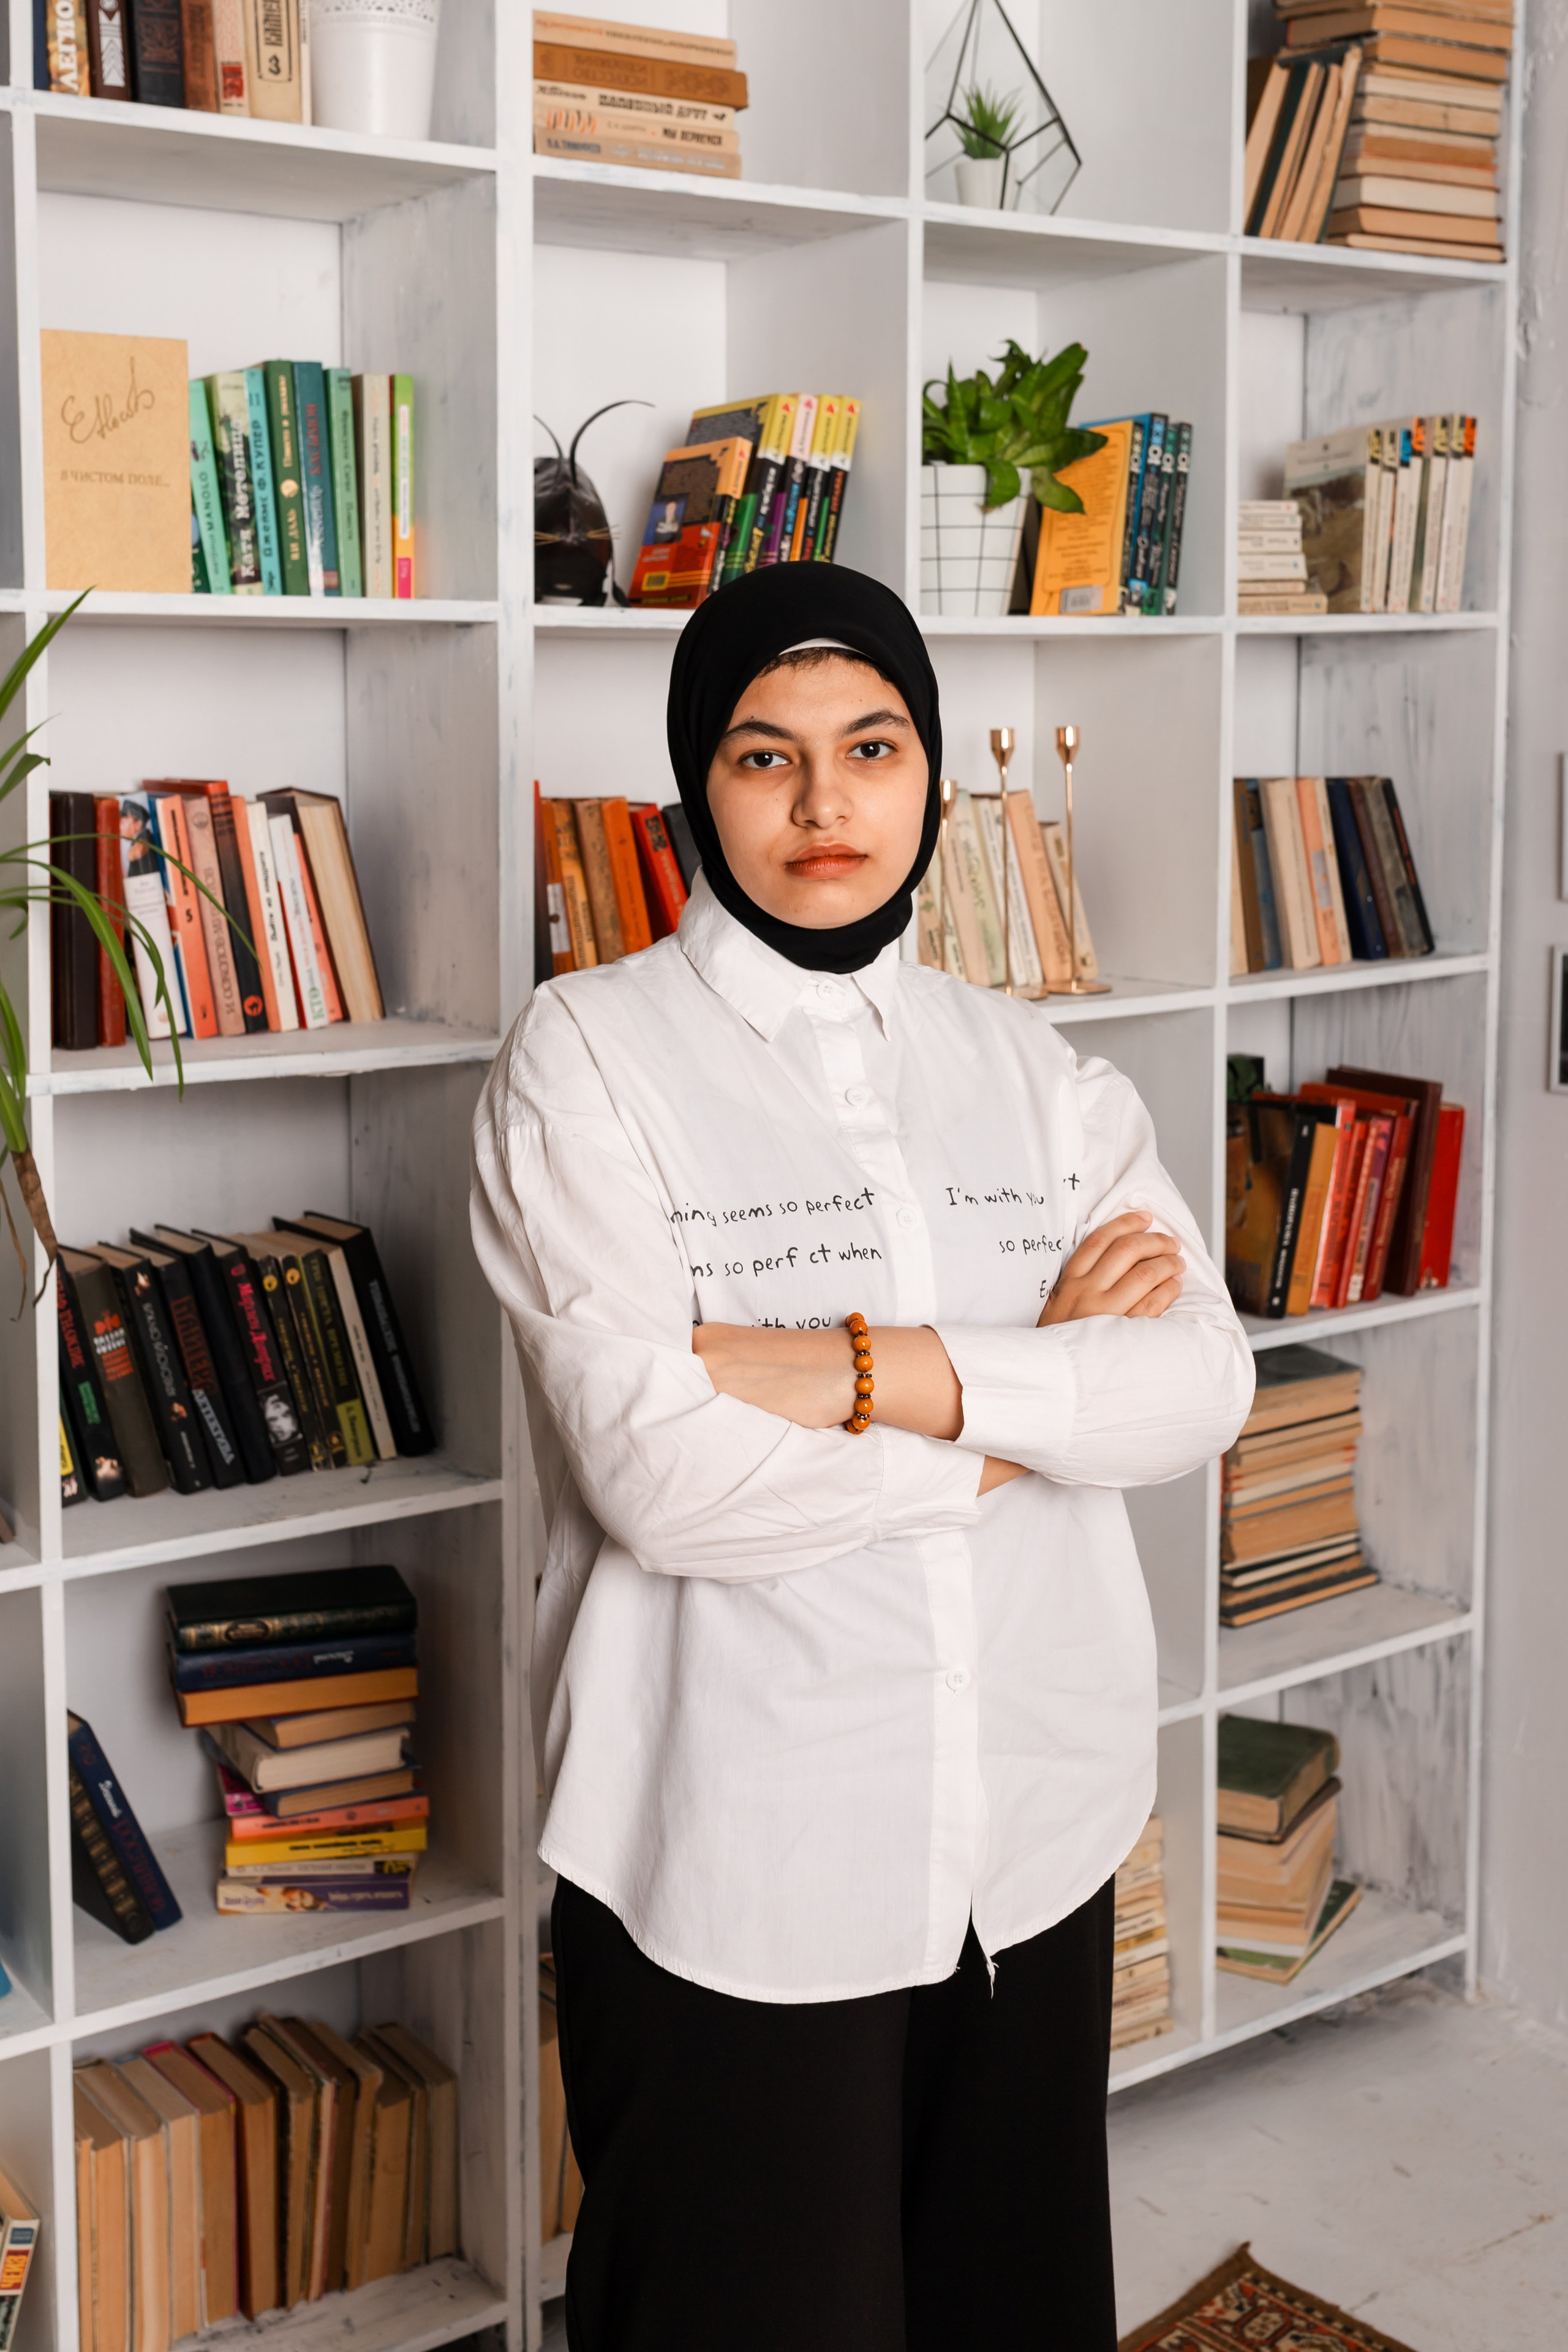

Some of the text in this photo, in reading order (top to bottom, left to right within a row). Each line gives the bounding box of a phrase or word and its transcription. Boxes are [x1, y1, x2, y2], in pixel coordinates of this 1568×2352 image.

[70, 470, 124, 484] ЧИСТОМ
[198, 471, 214, 530] MANOLO
[232, 420, 258, 578] Катя Метелица
[185, 908, 193, 922] 5
[723, 1203, 772, 1223] seems
[779, 1200, 797, 1214] so
[806, 1187, 875, 1215] perfect
[946, 1186, 978, 1205] I'm
[984, 1188, 1022, 1204] with
[725, 1261, 744, 1276] so
[839, 1242, 882, 1261] when
[999, 1234, 1065, 1256] so perfec
